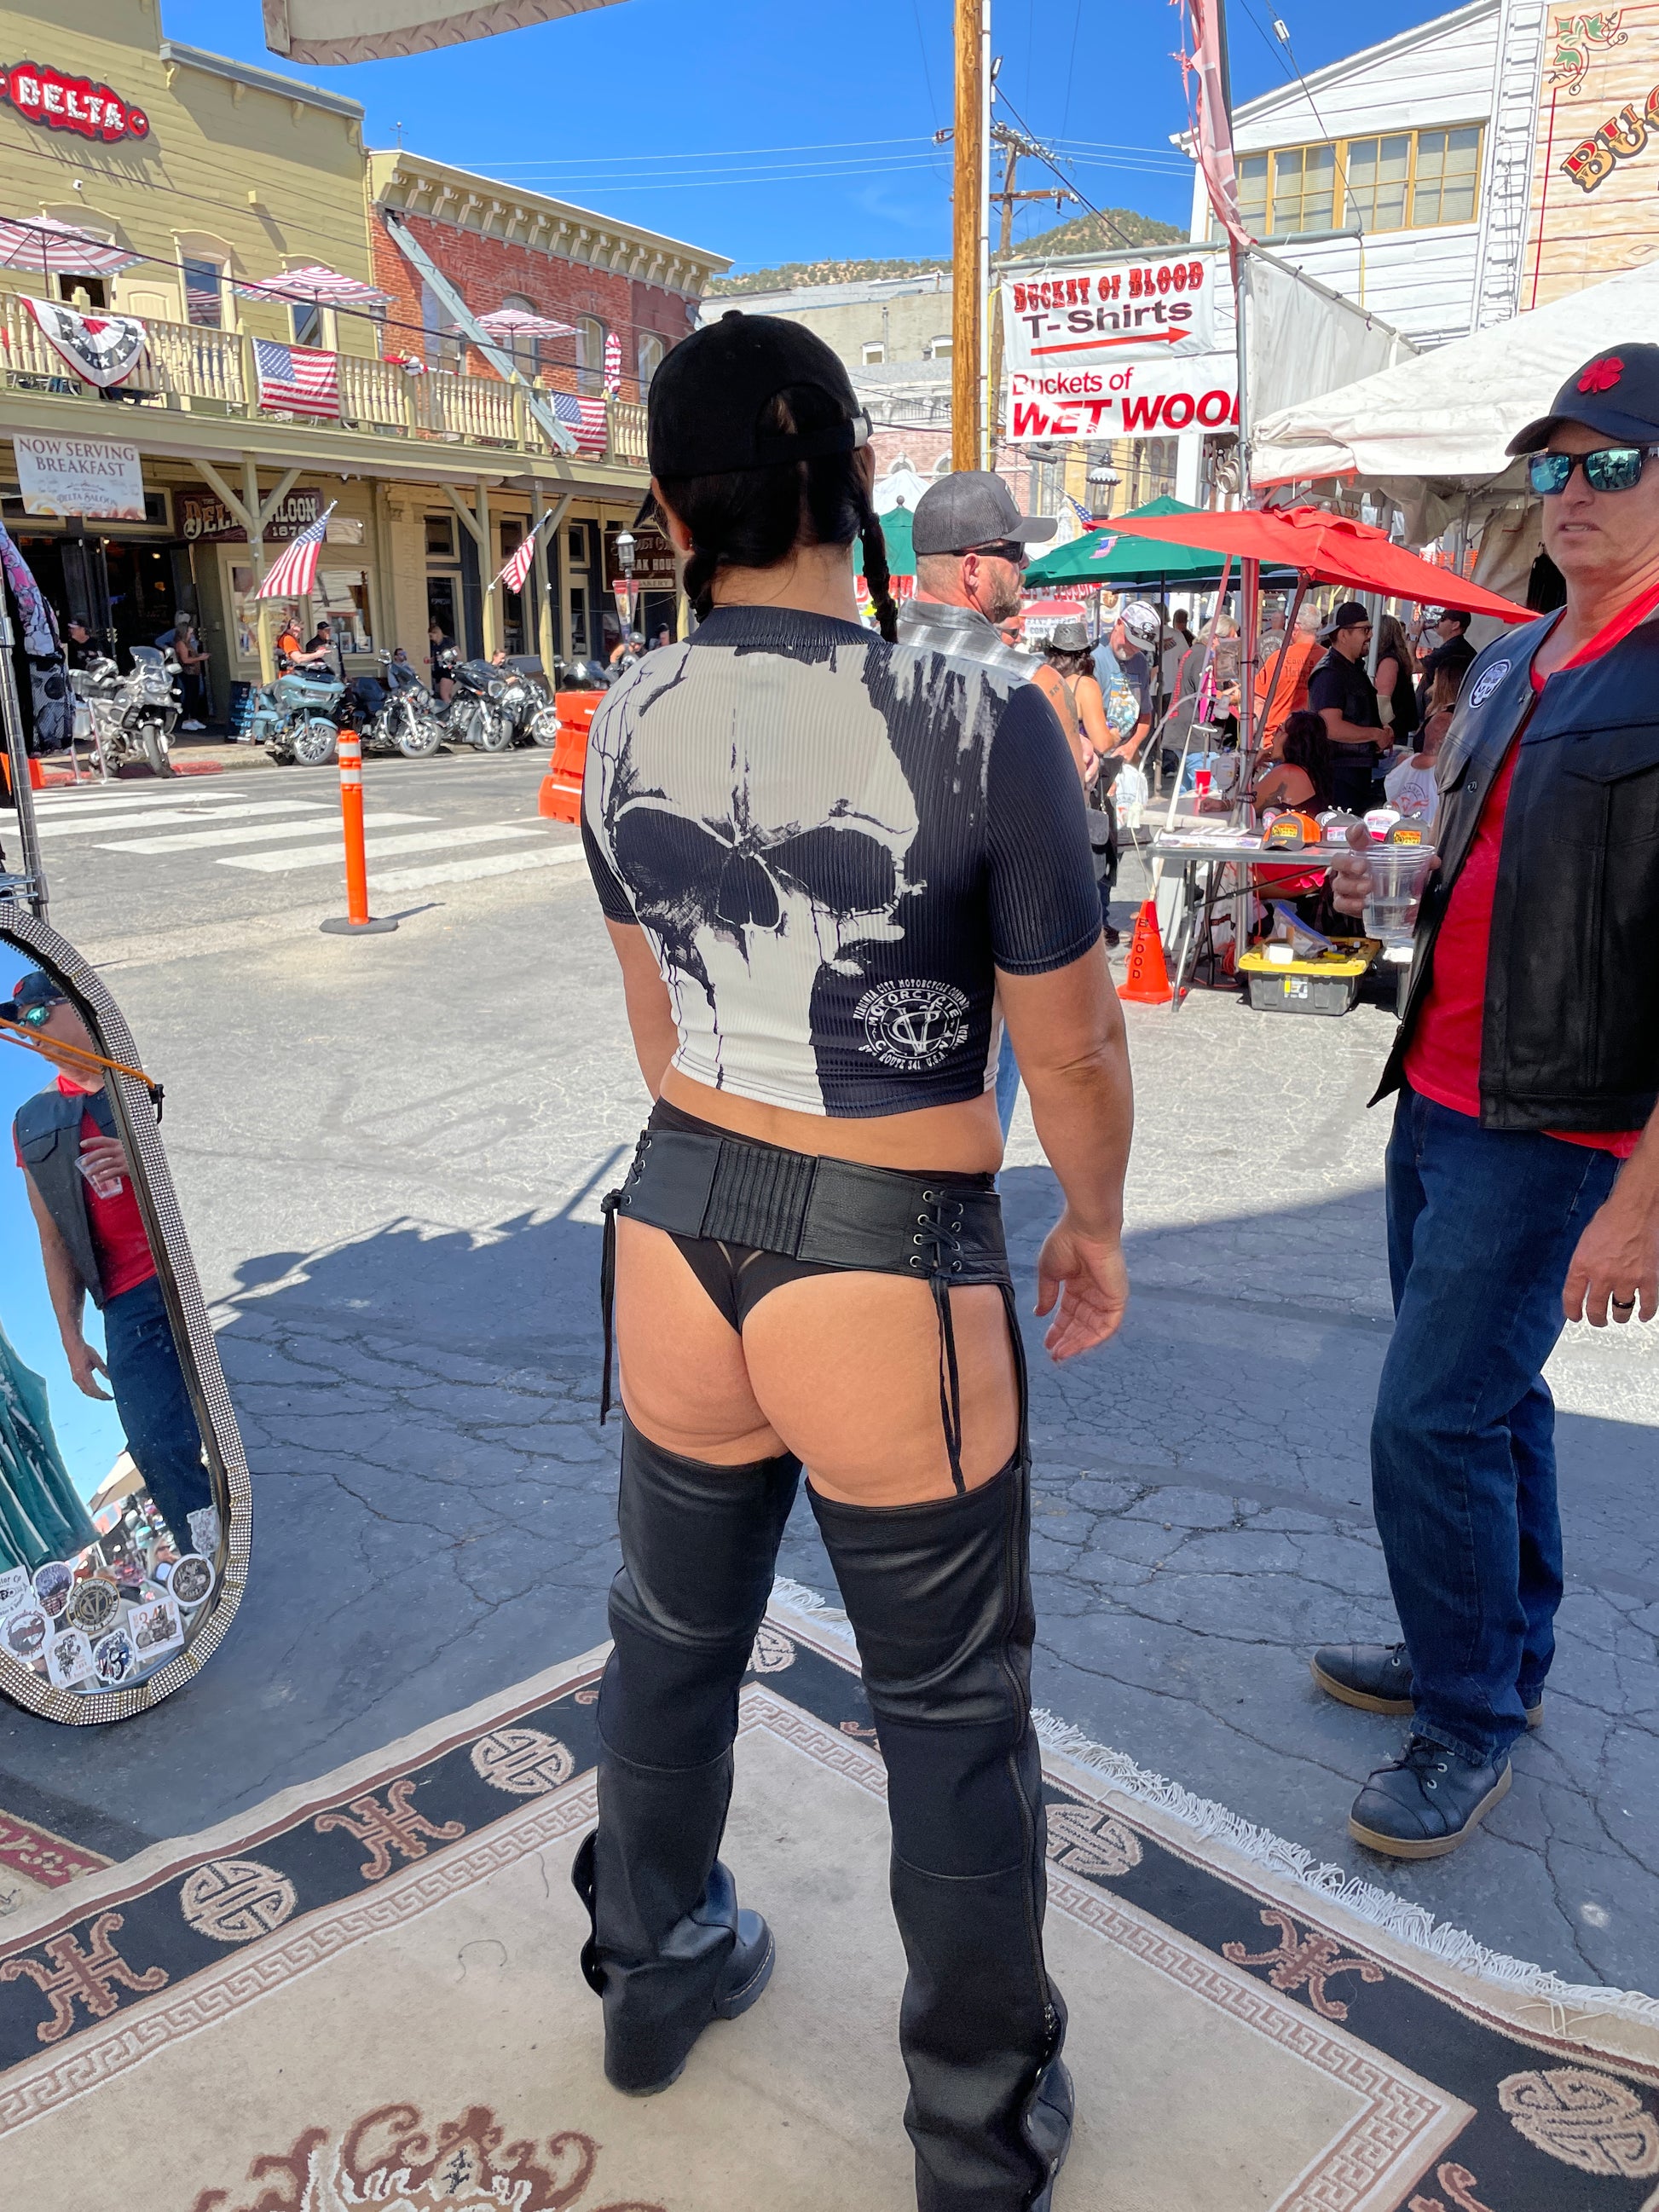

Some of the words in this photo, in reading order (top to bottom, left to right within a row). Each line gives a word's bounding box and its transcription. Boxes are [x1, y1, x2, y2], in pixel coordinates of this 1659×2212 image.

[18, 76, 124, 130] DELTA
[1013, 278, 1090, 313] BUCKET
[1097, 274, 1121, 302] OF
[1129, 261, 1205, 299] BLOOD
[1012, 371, 1103, 396] Buckets
[1109, 367, 1135, 390] of
[1013, 398, 1113, 436] WET
[19, 437, 61, 454] NOW
[66, 442, 135, 461] SERVING
[36, 457, 125, 476] BREAKFAST
[183, 500, 241, 540] DEL
[260, 497, 316, 523] LOON
[652, 558, 676, 571] HOUS
[1132, 917, 1149, 979] BLOOD
[853, 989, 879, 1019] VIRGINIA
[876, 980, 896, 994] CITY
[898, 979, 951, 993] MOTORCYCLE
[948, 987, 970, 1010] COMPAN
[868, 990, 960, 1026] MOTORCYCLE
[878, 1052, 905, 1070] ROUTE
[907, 1060, 922, 1070] 341
[926, 1051, 948, 1067] U.S.A.
